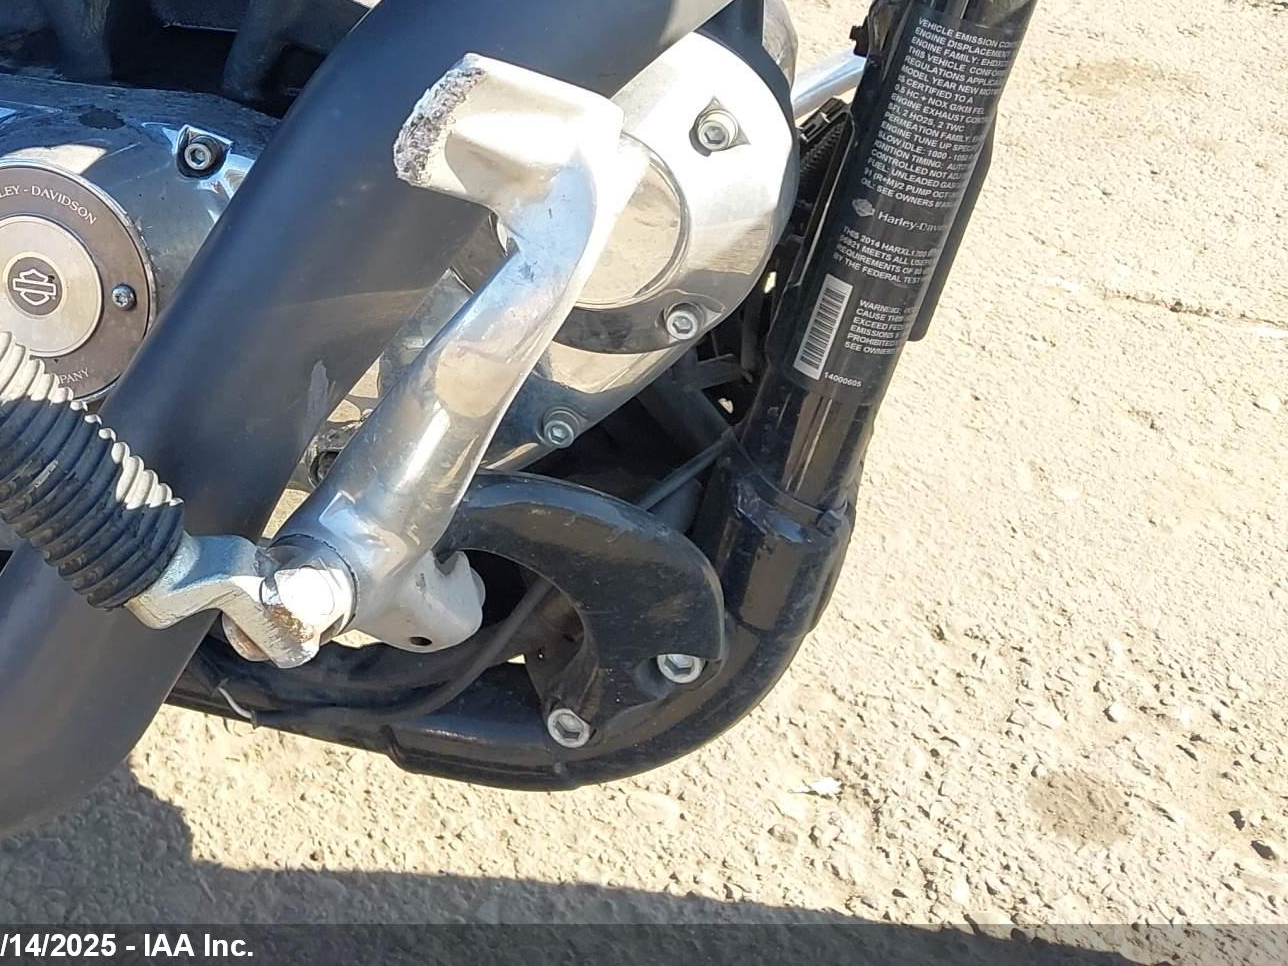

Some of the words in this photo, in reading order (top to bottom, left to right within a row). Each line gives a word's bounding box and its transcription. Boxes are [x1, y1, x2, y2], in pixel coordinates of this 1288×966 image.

[914, 26, 945, 44] ENGINE
[917, 16, 953, 36] VEHICLE
[954, 31, 997, 47] EMISSION
[908, 45, 925, 58] THIS
[926, 52, 966, 71] VEHICLE
[910, 35, 943, 54] ENGINE
[943, 48, 980, 64] FAMILY:
[900, 64, 930, 82] MODEL
[931, 76, 956, 90] YEAR
[957, 84, 978, 95] NEW
[904, 54, 965, 81] REGULATIONS
[905, 78, 952, 100] CERTIFIED
[953, 93, 966, 102] TO
[905, 88, 919, 99] HC
[927, 96, 948, 108] NOX
[890, 92, 921, 110] ENGINE
[922, 105, 964, 122] EXHAUST
[880, 120, 912, 139] ENGINE
[912, 134, 937, 147] TUNE
[938, 141, 952, 150] UP
[883, 110, 940, 137] PERMEATION
[937, 120, 943, 128] 2
[945, 122, 965, 132] TWC
[873, 139, 910, 159] IGNITION
[910, 154, 944, 169] TIMING:
[877, 129, 901, 146] SLOW
[901, 140, 925, 154] IDLE:
[867, 157, 889, 173] FUEL:
[890, 167, 940, 188] UNLEADED
[871, 148, 928, 175] CONTROLLED
[928, 168, 947, 179] NOT
[876, 184, 894, 197] SEE
[894, 191, 934, 207] OWNERS
[905, 183, 932, 196] PUMP
[31, 185, 97, 225] DAVIDSON
[859, 234, 881, 247] 2014
[861, 245, 892, 261] MEETS
[892, 255, 909, 265] ALL
[843, 258, 860, 271] THE
[861, 265, 902, 283] FEDERAL
[902, 276, 920, 284] TEST
[901, 266, 913, 275] OF
[852, 315, 888, 330] EXCEED
[855, 307, 886, 321] CAUSE
[849, 324, 894, 340] EMISSIONS
[843, 340, 862, 351] SEE
